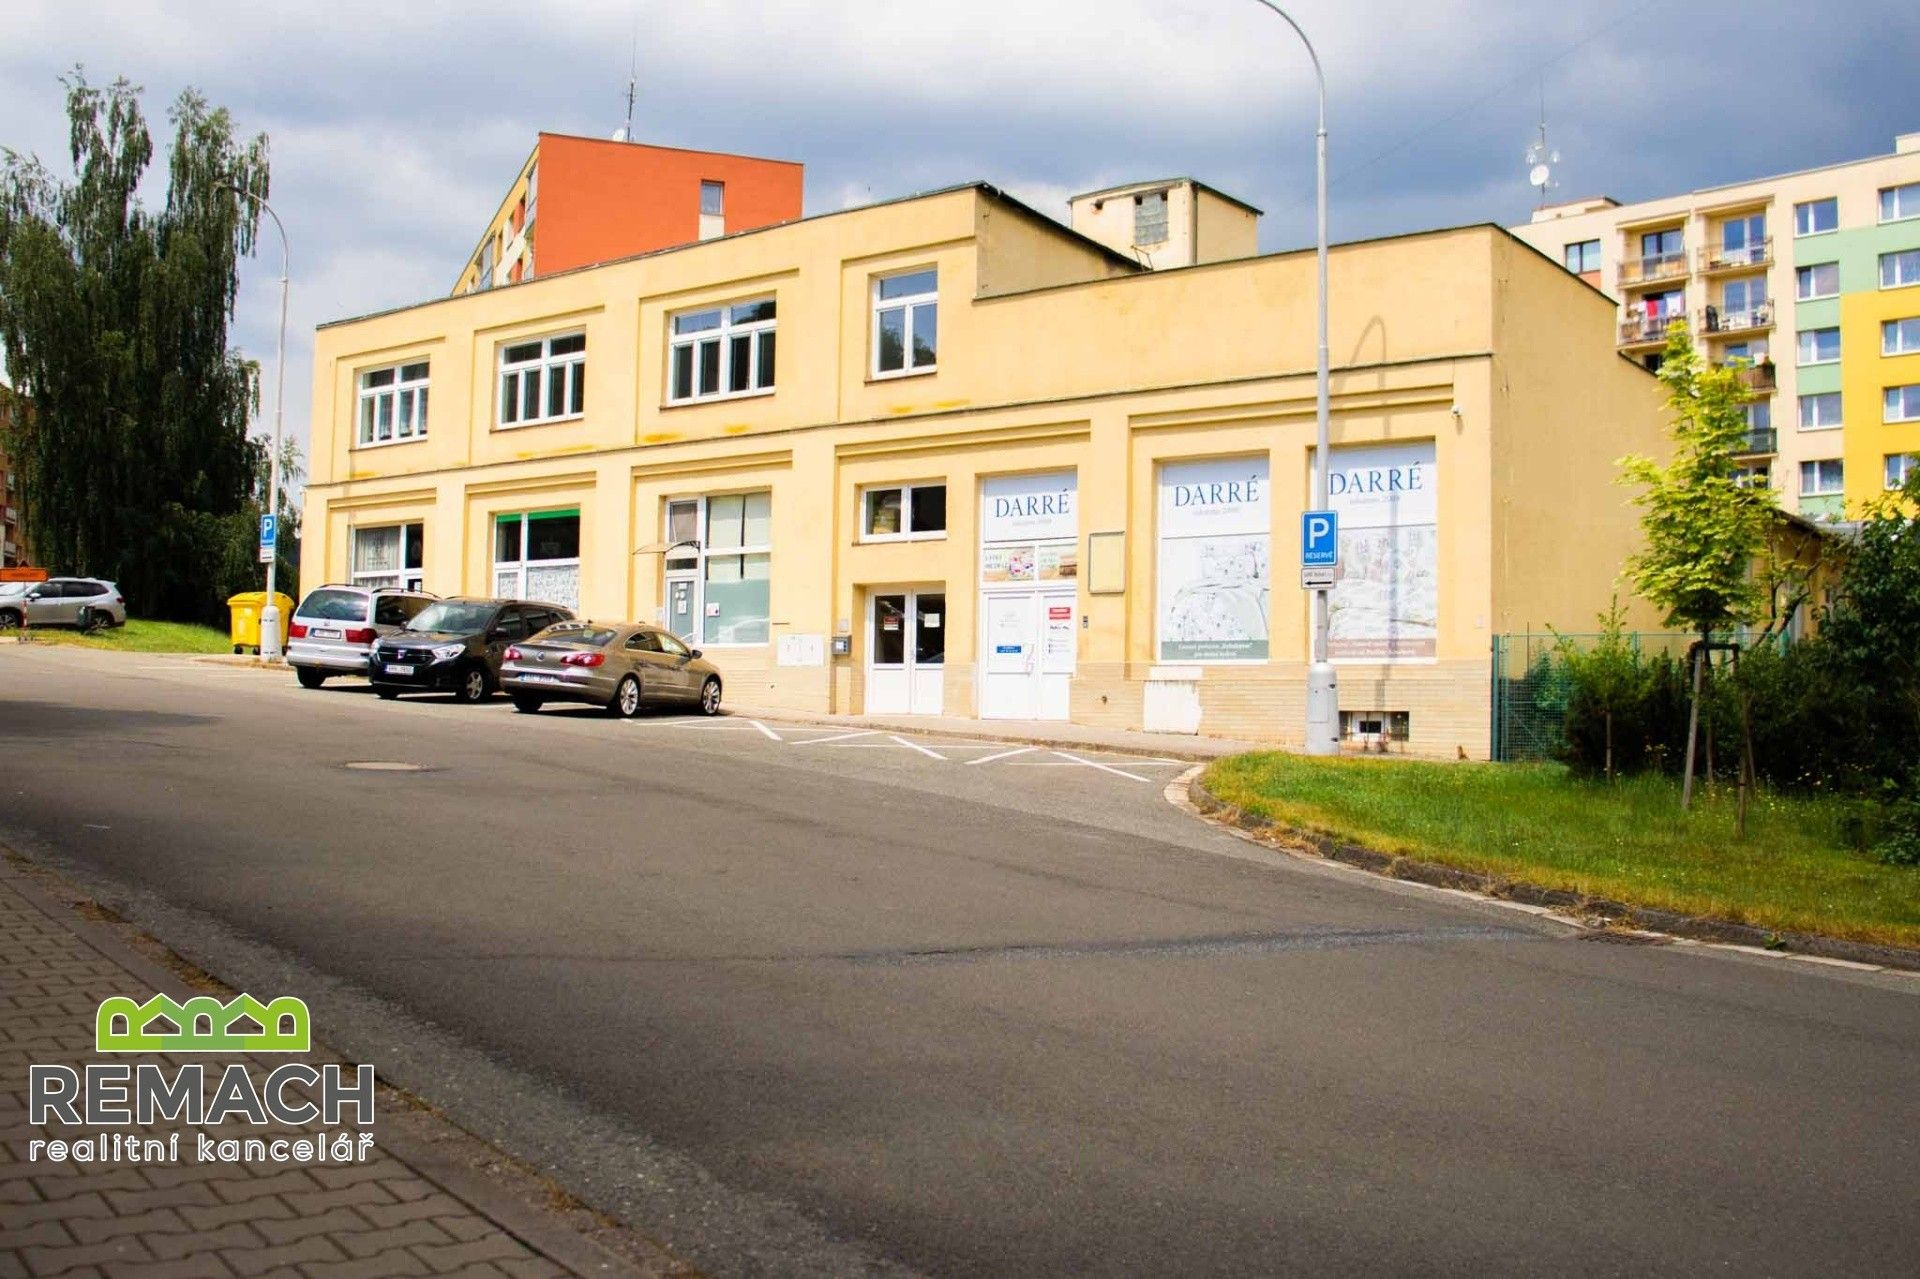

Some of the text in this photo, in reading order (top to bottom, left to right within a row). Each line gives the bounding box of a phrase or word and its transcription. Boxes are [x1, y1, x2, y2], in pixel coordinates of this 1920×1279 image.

[1175, 474, 1260, 507] DARRÉ
[1328, 460, 1423, 496] DARRÉ
[995, 488, 1070, 518] DARRÉ
[263, 518, 273, 539] P
[1309, 517, 1330, 549] P
